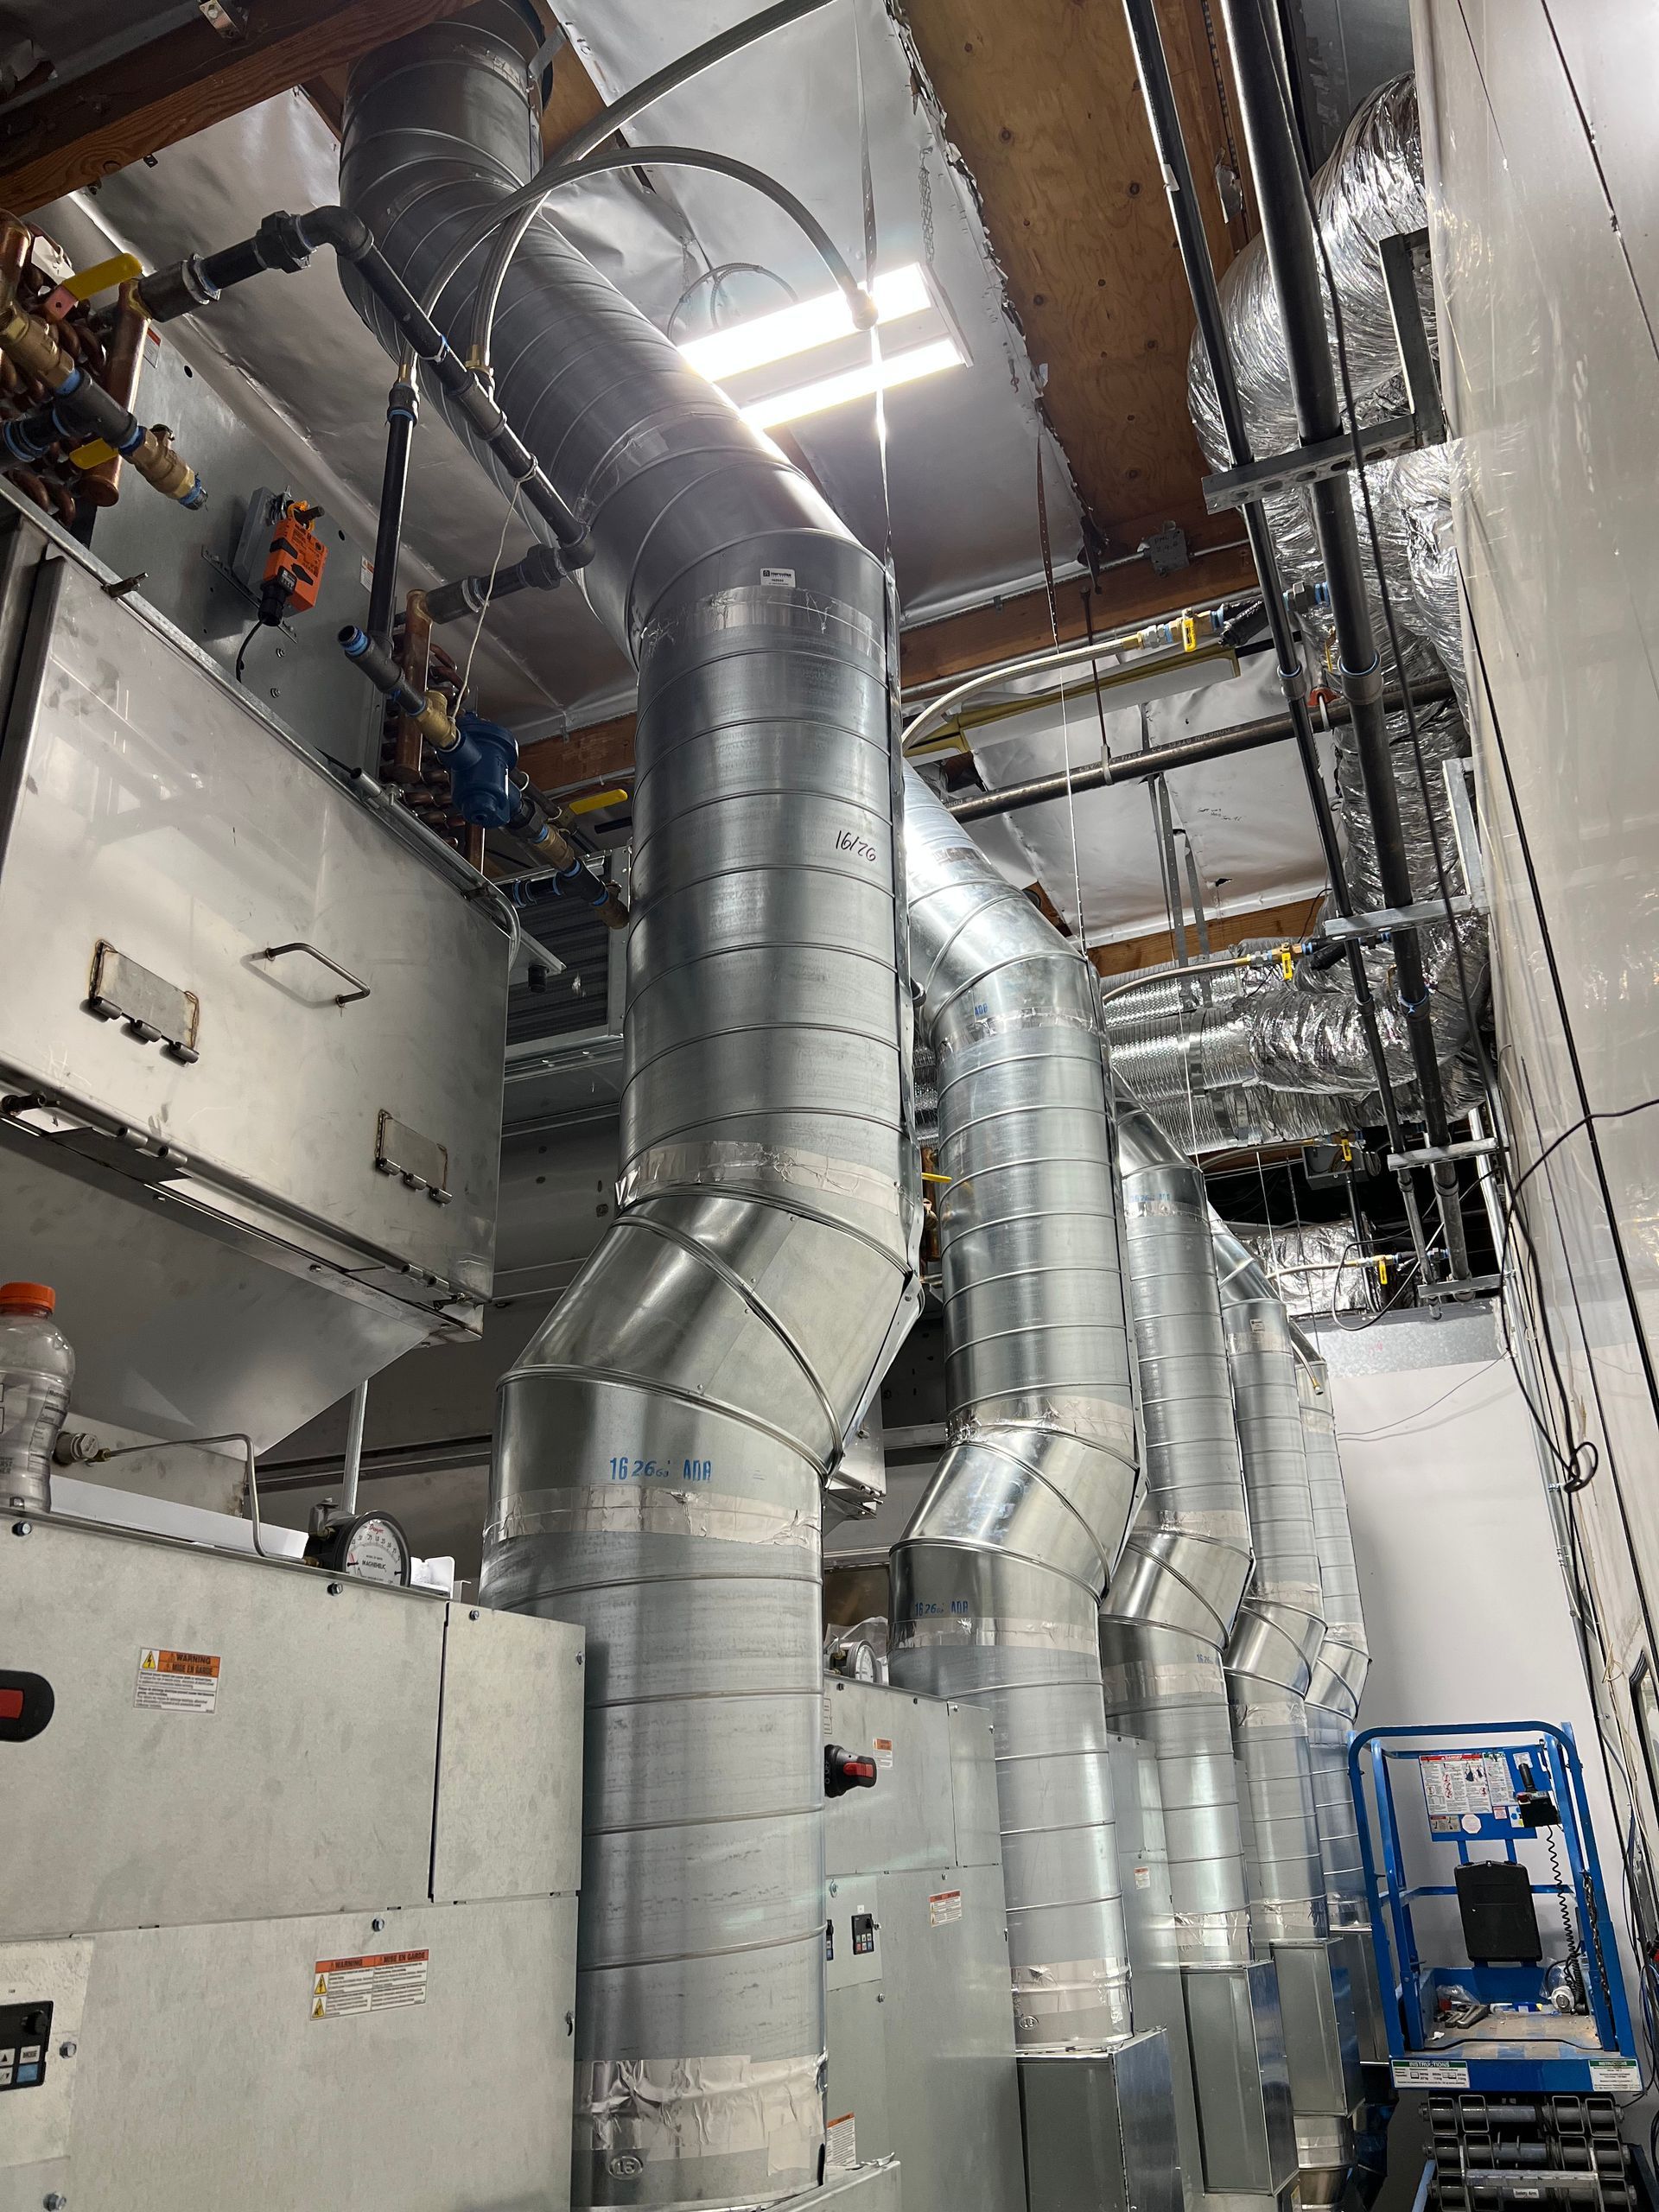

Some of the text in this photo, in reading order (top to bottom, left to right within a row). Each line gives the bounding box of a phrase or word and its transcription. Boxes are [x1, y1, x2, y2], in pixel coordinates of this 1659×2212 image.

[610, 1457, 629, 1480] 16
[915, 1602, 924, 1617] 16
[176, 1652, 211, 1665] WARNING
[172, 1663, 213, 1675] MISE EN GARDE
[334, 1959, 363, 1969] WARNING
[384, 1954, 397, 1963] MISE
[407, 1951, 425, 1961] GARDE
